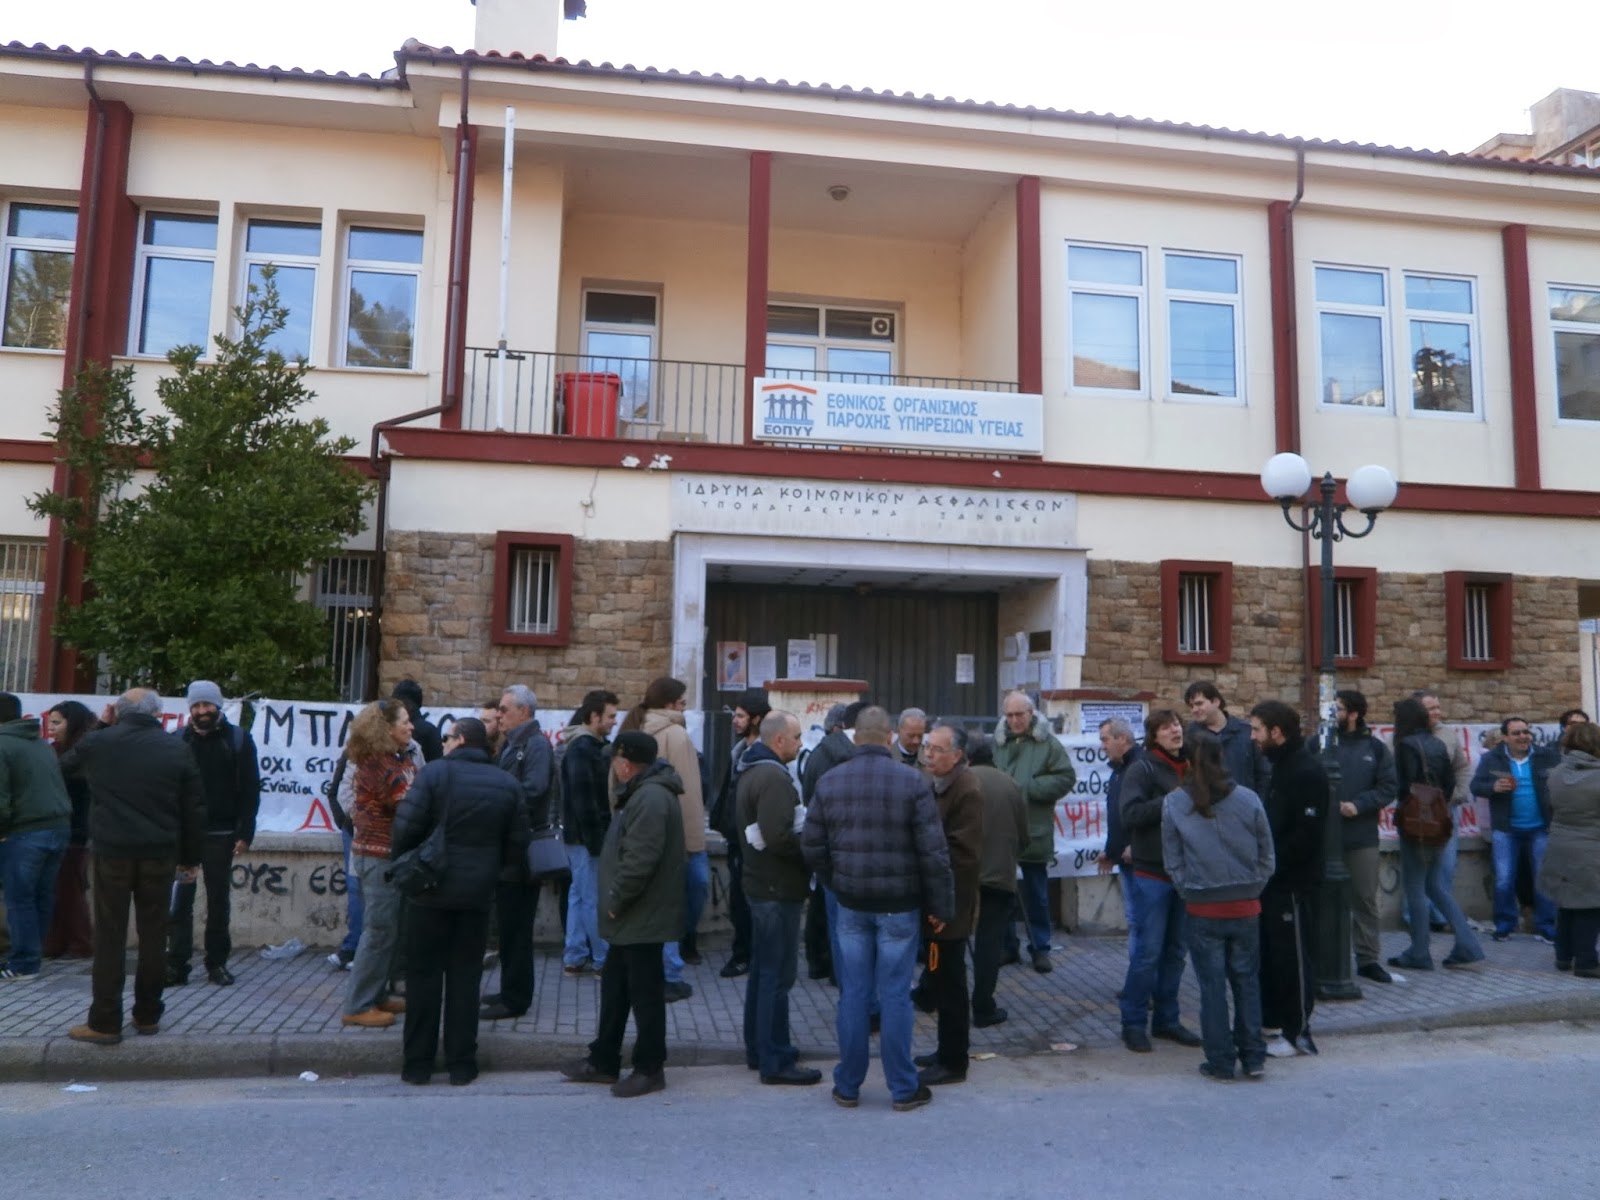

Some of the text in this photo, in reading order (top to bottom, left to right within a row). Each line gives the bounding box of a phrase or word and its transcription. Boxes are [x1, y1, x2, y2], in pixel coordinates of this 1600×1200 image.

[827, 393, 979, 417] ΕΘΝΙΚΟΣ ΟΡΓΑΝΙΣΜΟΣ
[763, 424, 813, 436] ΕΟΠΥΥ
[827, 411, 1024, 437] ΠΑΡΟΧΗΣ ΥΠΗΡΕΣΙΩΝ ΥΓΕΙΑΣ
[687, 482, 1063, 511] ΙΔΡΥΜΑ ΚΟΙΝΩΝΙΚΩΝ ΑΣΦΑΛΙΣΕΩΝ
[702, 500, 897, 517] ΥΠΟΚΑΤΑΣΤΗΜΑ
